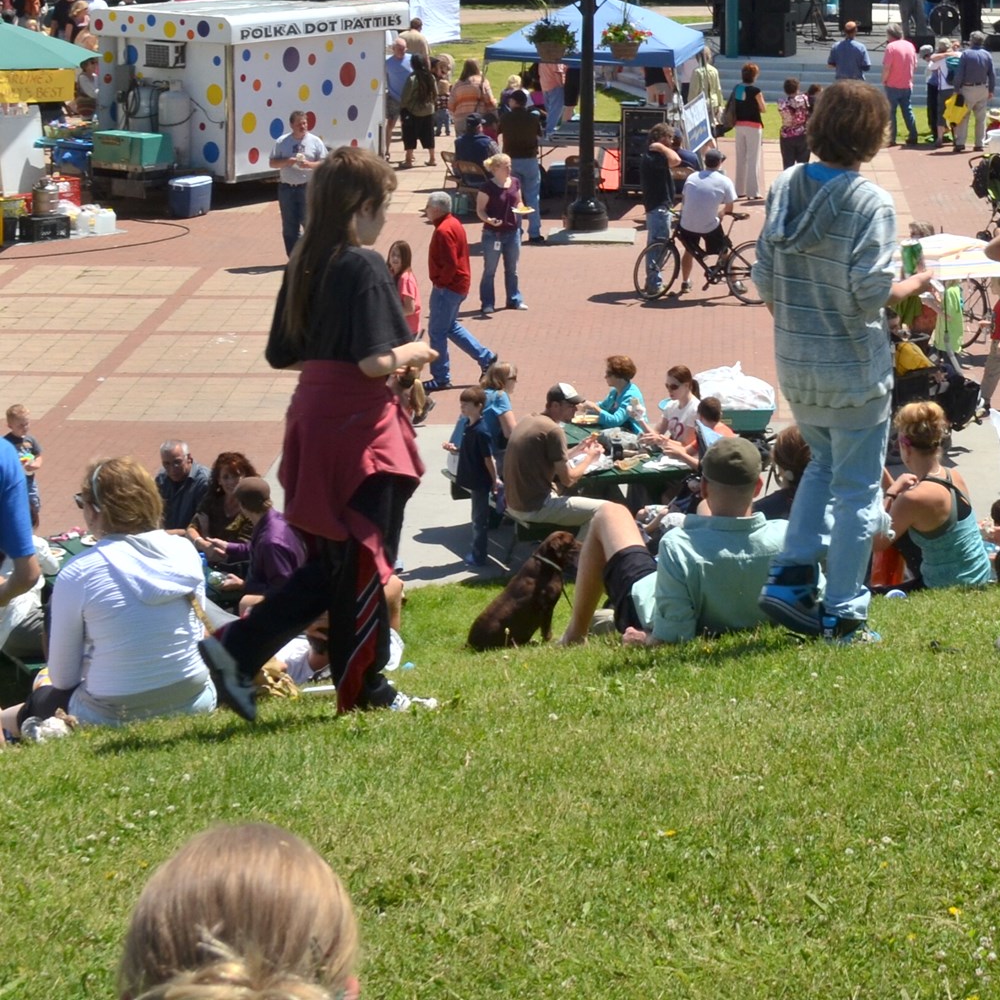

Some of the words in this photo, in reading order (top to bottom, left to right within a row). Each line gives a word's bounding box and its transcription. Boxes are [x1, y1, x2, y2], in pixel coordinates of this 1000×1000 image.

[240, 22, 301, 41] POLKA
[304, 20, 338, 35] DOT
[341, 14, 403, 31] PATTIES
